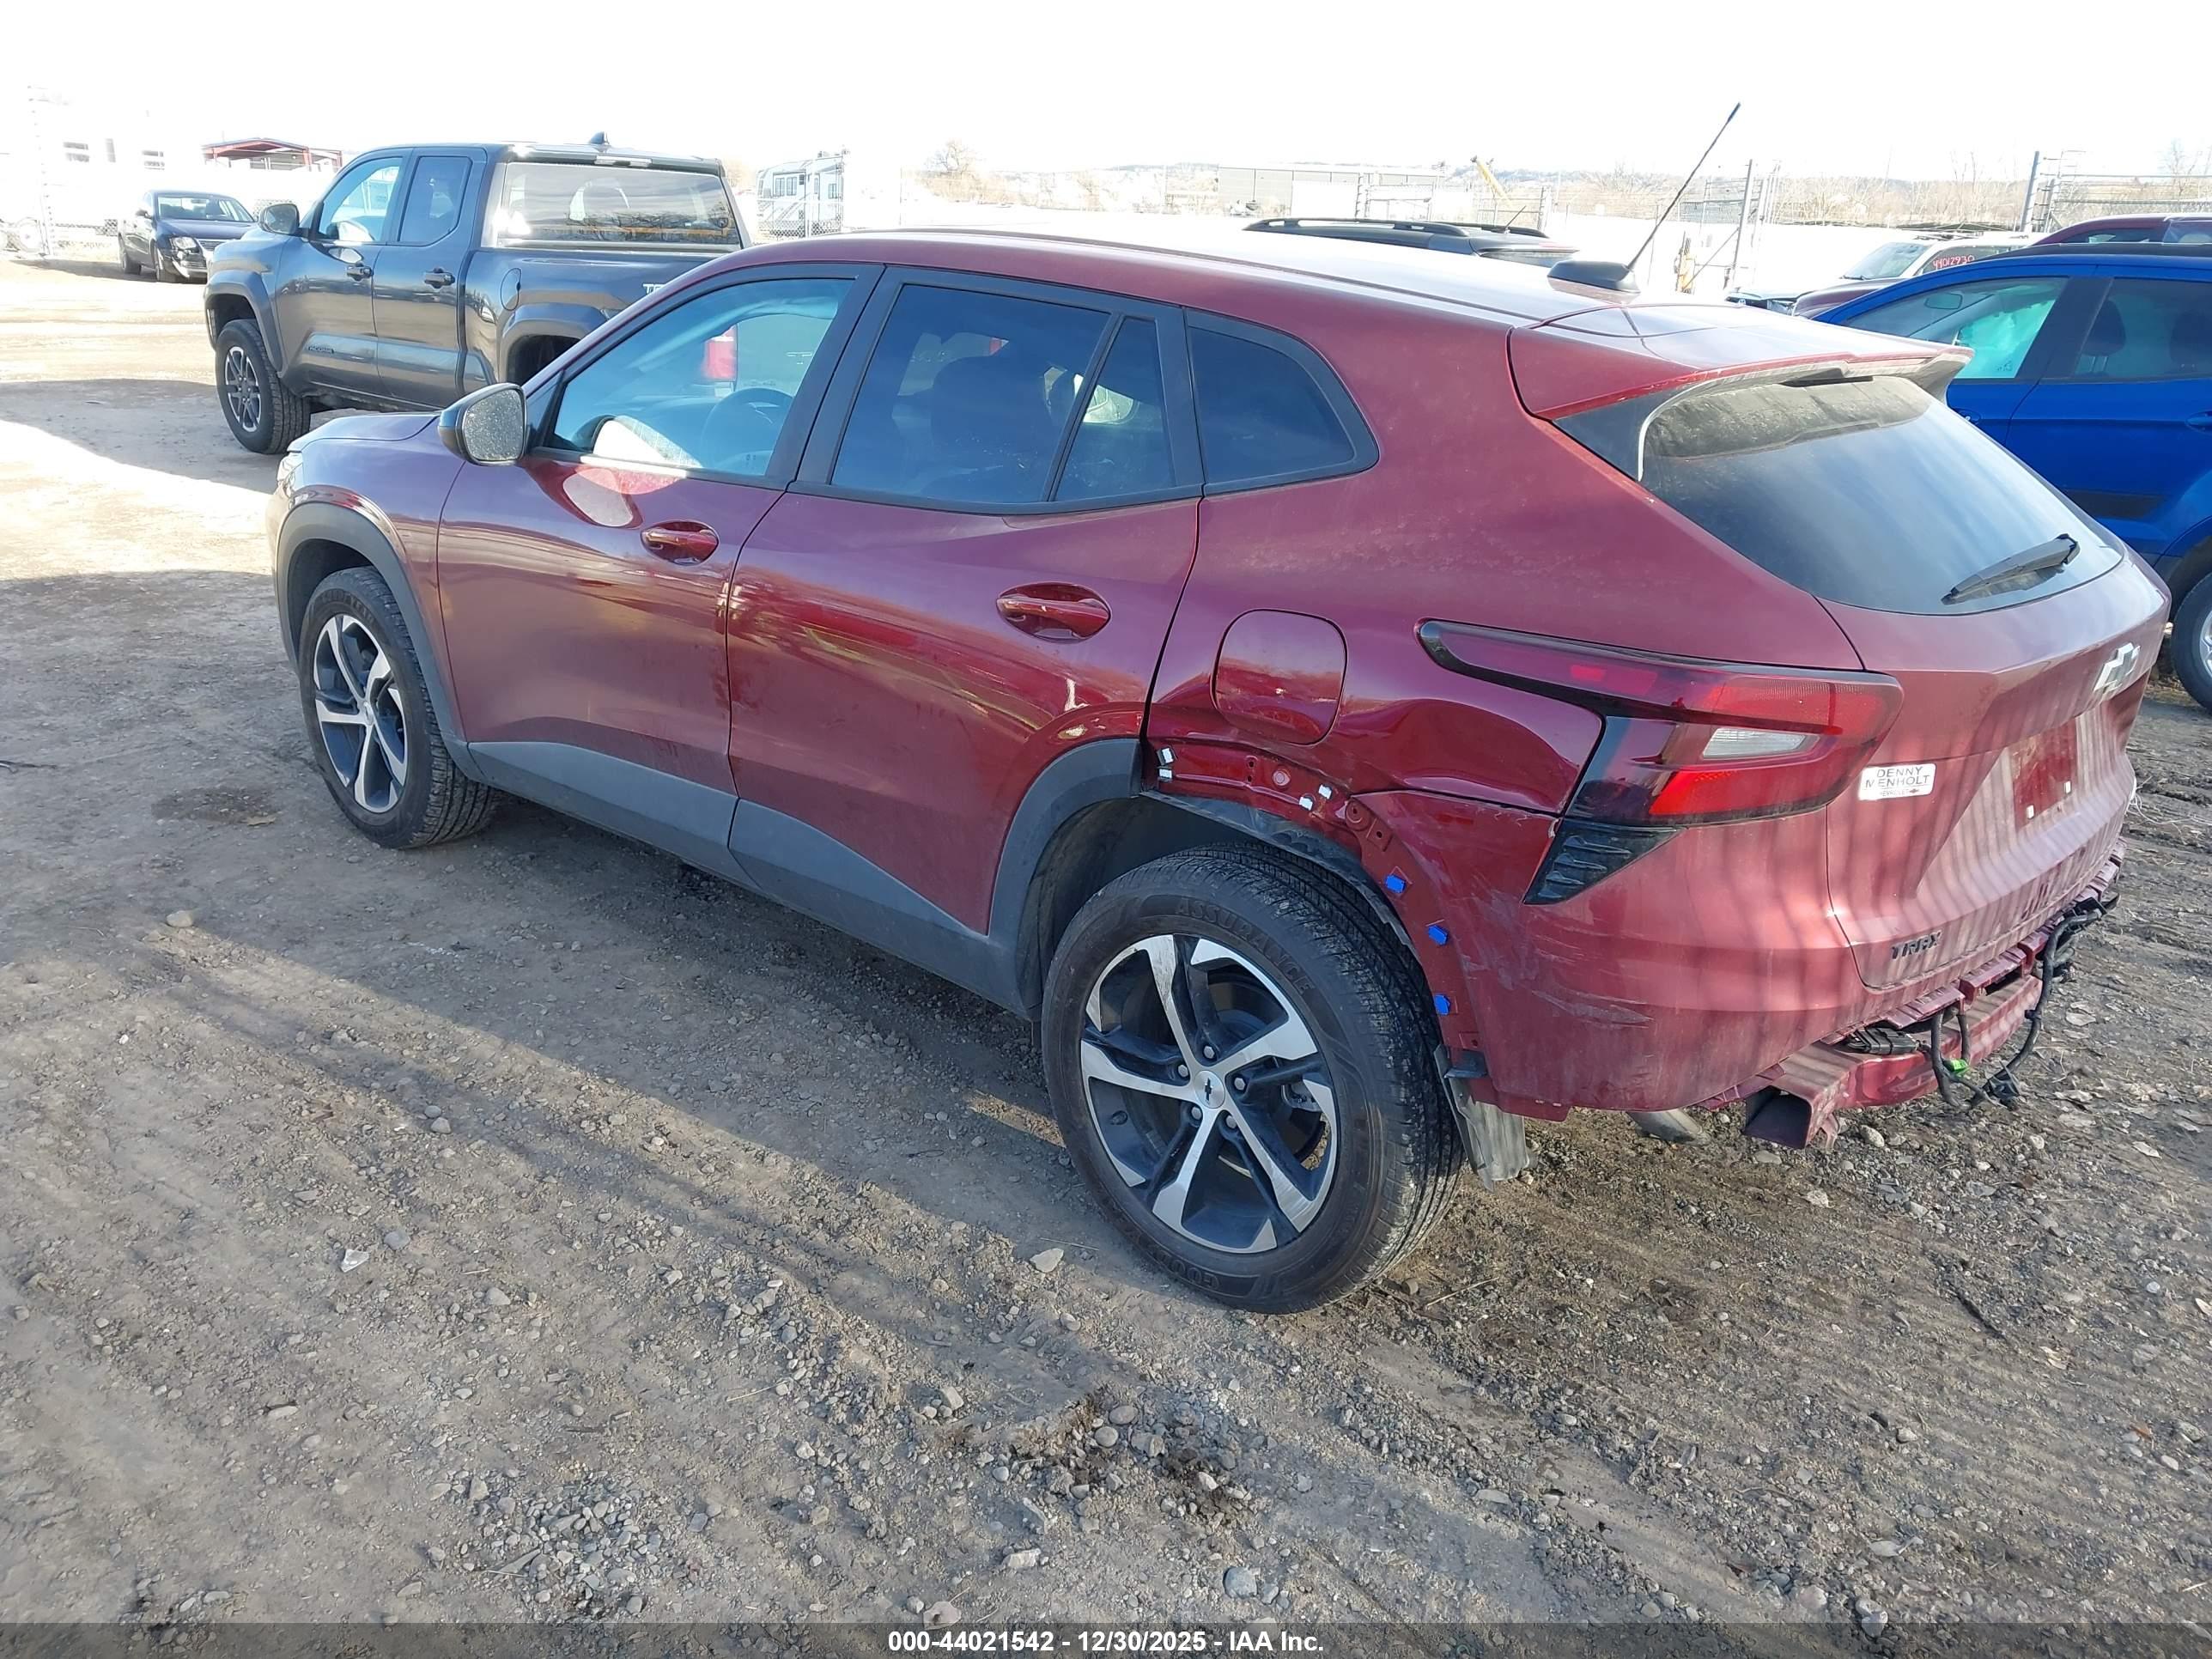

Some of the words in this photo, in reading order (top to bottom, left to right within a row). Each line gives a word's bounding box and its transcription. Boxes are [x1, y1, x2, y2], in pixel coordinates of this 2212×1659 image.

[1876, 766, 1923, 778] DENNY
[1176, 896, 1316, 996] ASSURANCE
[1891, 930, 1942, 960] TRAX
